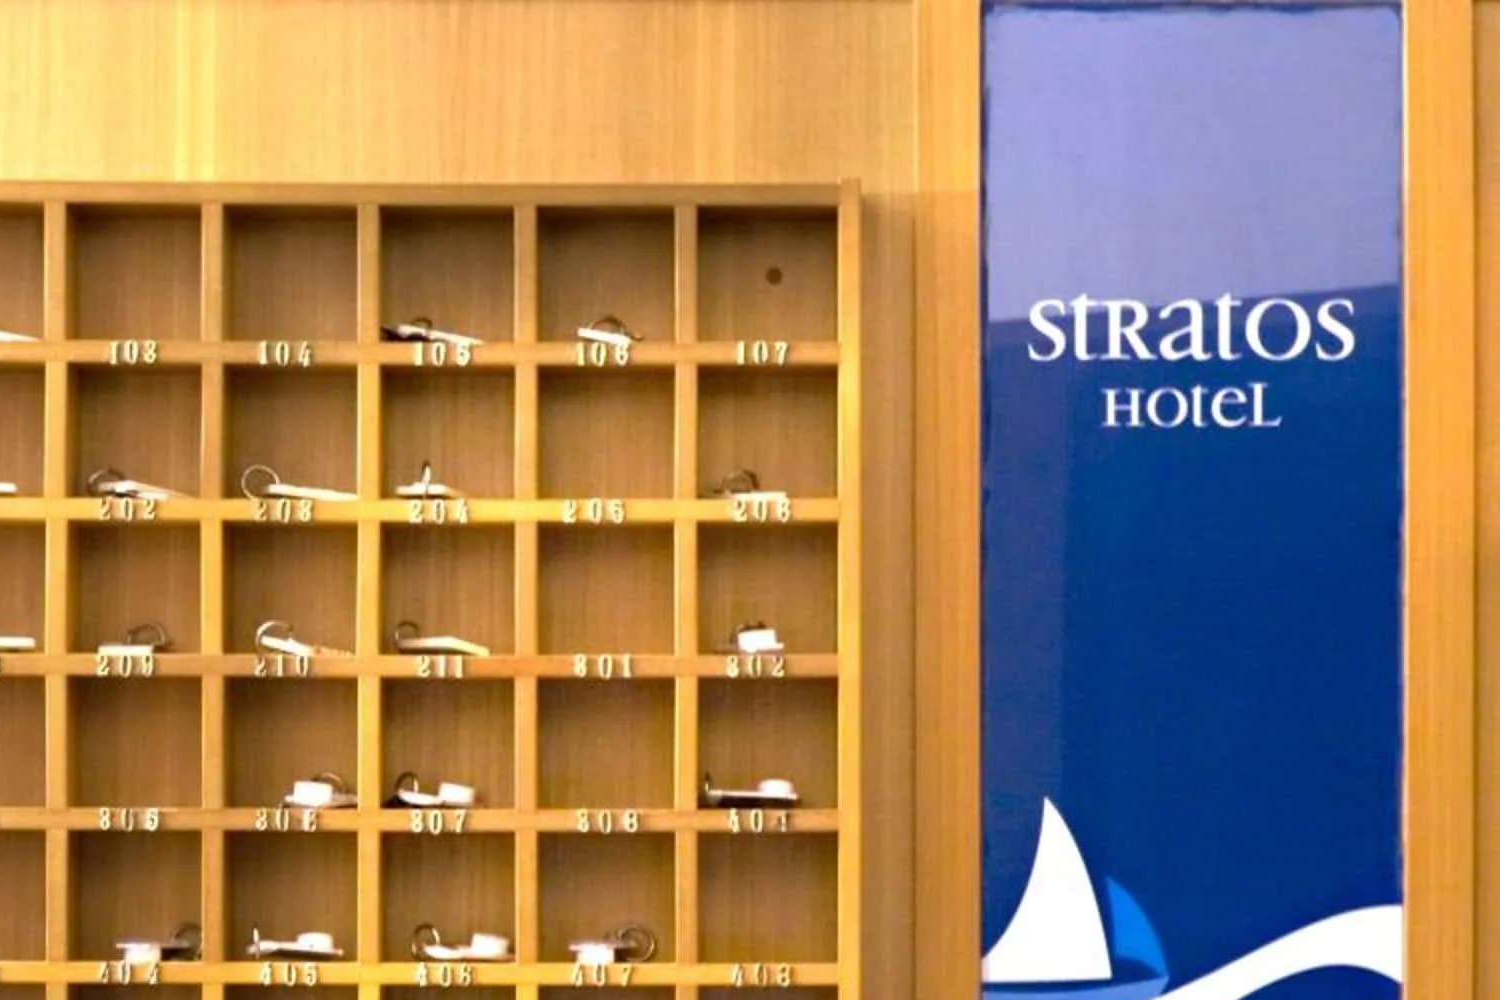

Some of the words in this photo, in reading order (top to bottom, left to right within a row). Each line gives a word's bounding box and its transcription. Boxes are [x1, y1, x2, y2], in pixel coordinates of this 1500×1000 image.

[259, 340, 310, 367] 104
[413, 341, 470, 366] 105
[576, 341, 628, 367] 106
[736, 340, 788, 367] 107
[100, 497, 155, 521] 202
[409, 499, 467, 524] 204
[97, 654, 153, 678] 209
[254, 654, 308, 678] 210
[418, 655, 463, 679] 211
[260, 961, 317, 987] 405
[572, 963, 633, 988] 407
